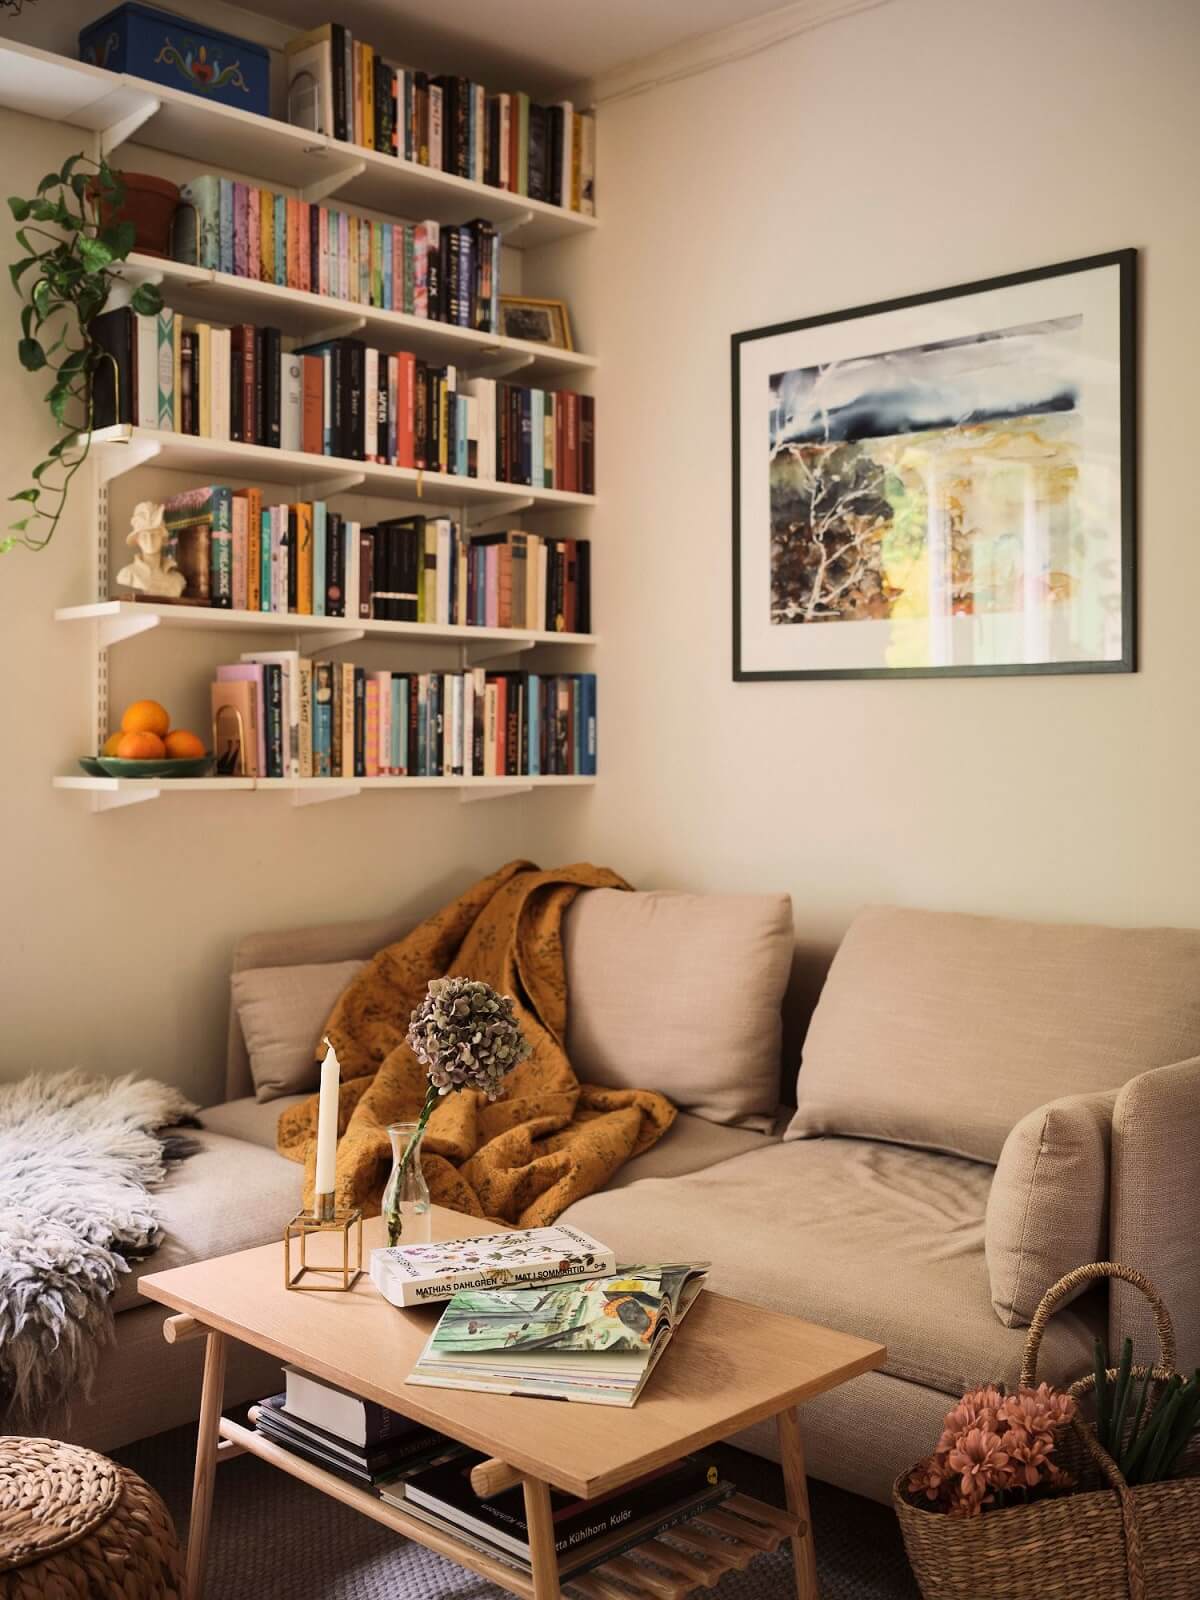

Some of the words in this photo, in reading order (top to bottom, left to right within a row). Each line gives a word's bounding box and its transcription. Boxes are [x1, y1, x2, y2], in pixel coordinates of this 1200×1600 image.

[415, 1284, 452, 1297] MATHIAS
[453, 1278, 498, 1291] DAHLGREN
[514, 1271, 532, 1282] MAT
[537, 1265, 586, 1280] SOMMARTID
[555, 1537, 568, 1552] tta
[569, 1521, 607, 1545] Kühlhorn
[610, 1509, 633, 1525] Kulör
